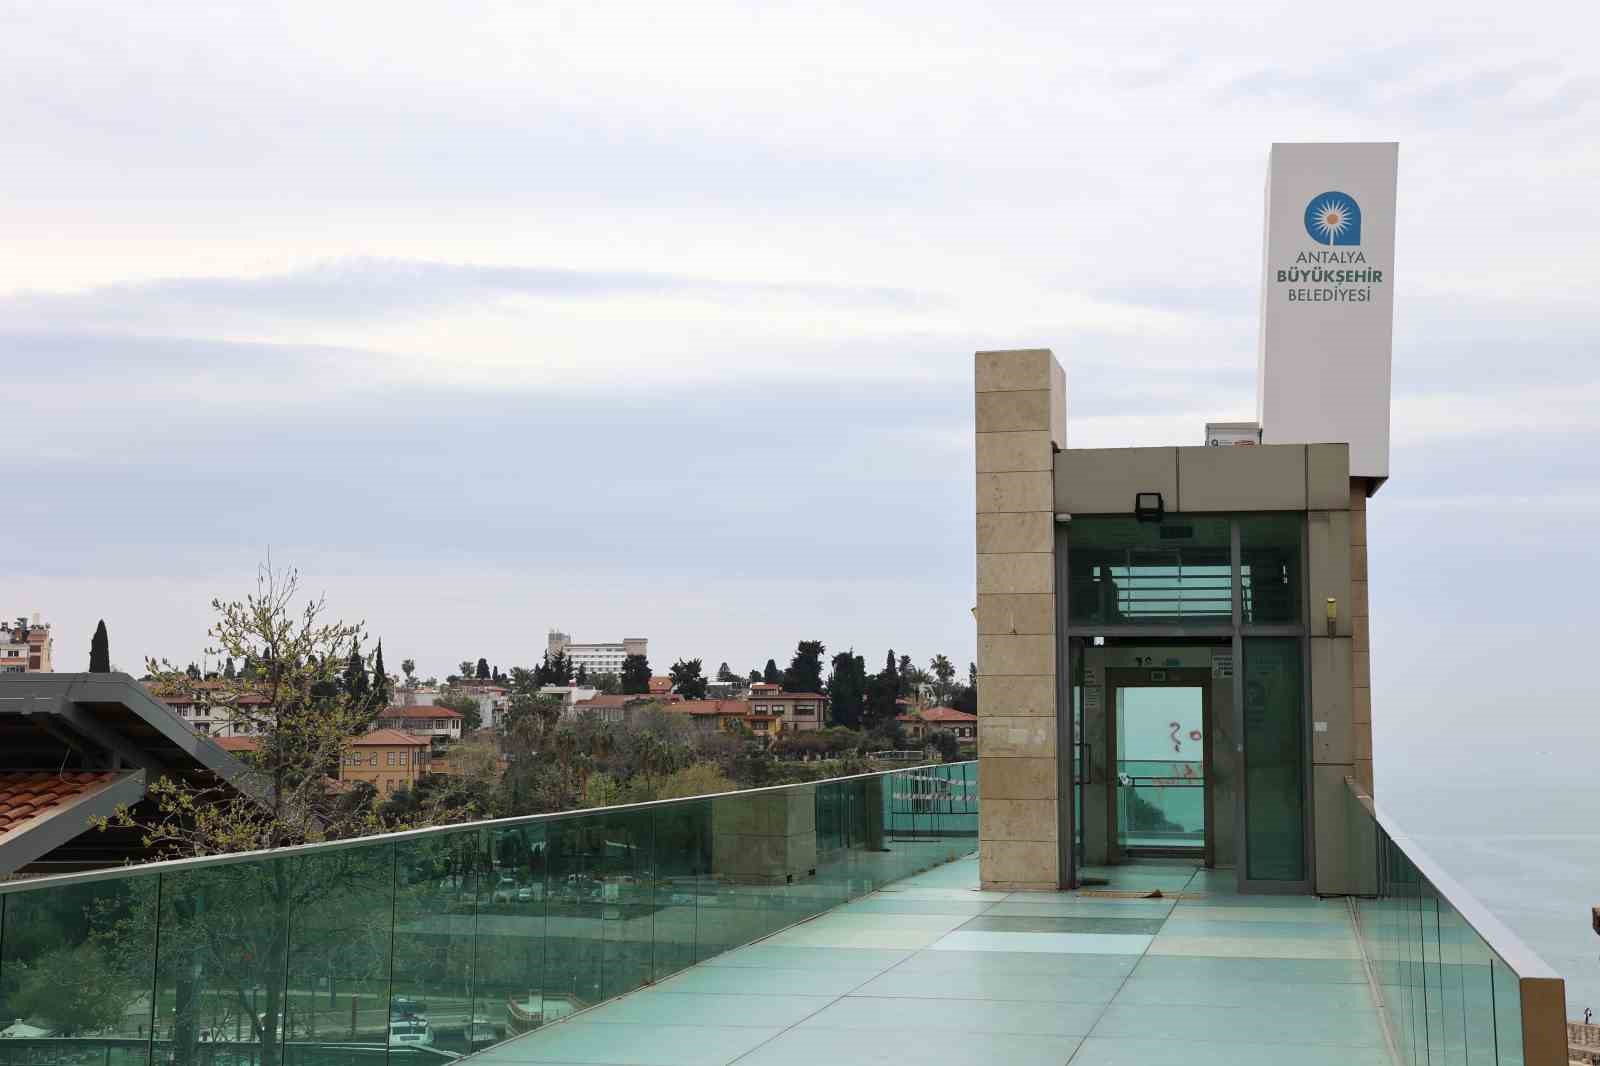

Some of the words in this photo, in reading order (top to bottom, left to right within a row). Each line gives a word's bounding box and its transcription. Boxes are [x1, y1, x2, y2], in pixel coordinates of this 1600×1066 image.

[1295, 251, 1366, 264] ANTALYA
[1277, 266, 1383, 285] BÜYÜKŞEHİR
[1288, 286, 1371, 302] BELEDİYESİ
